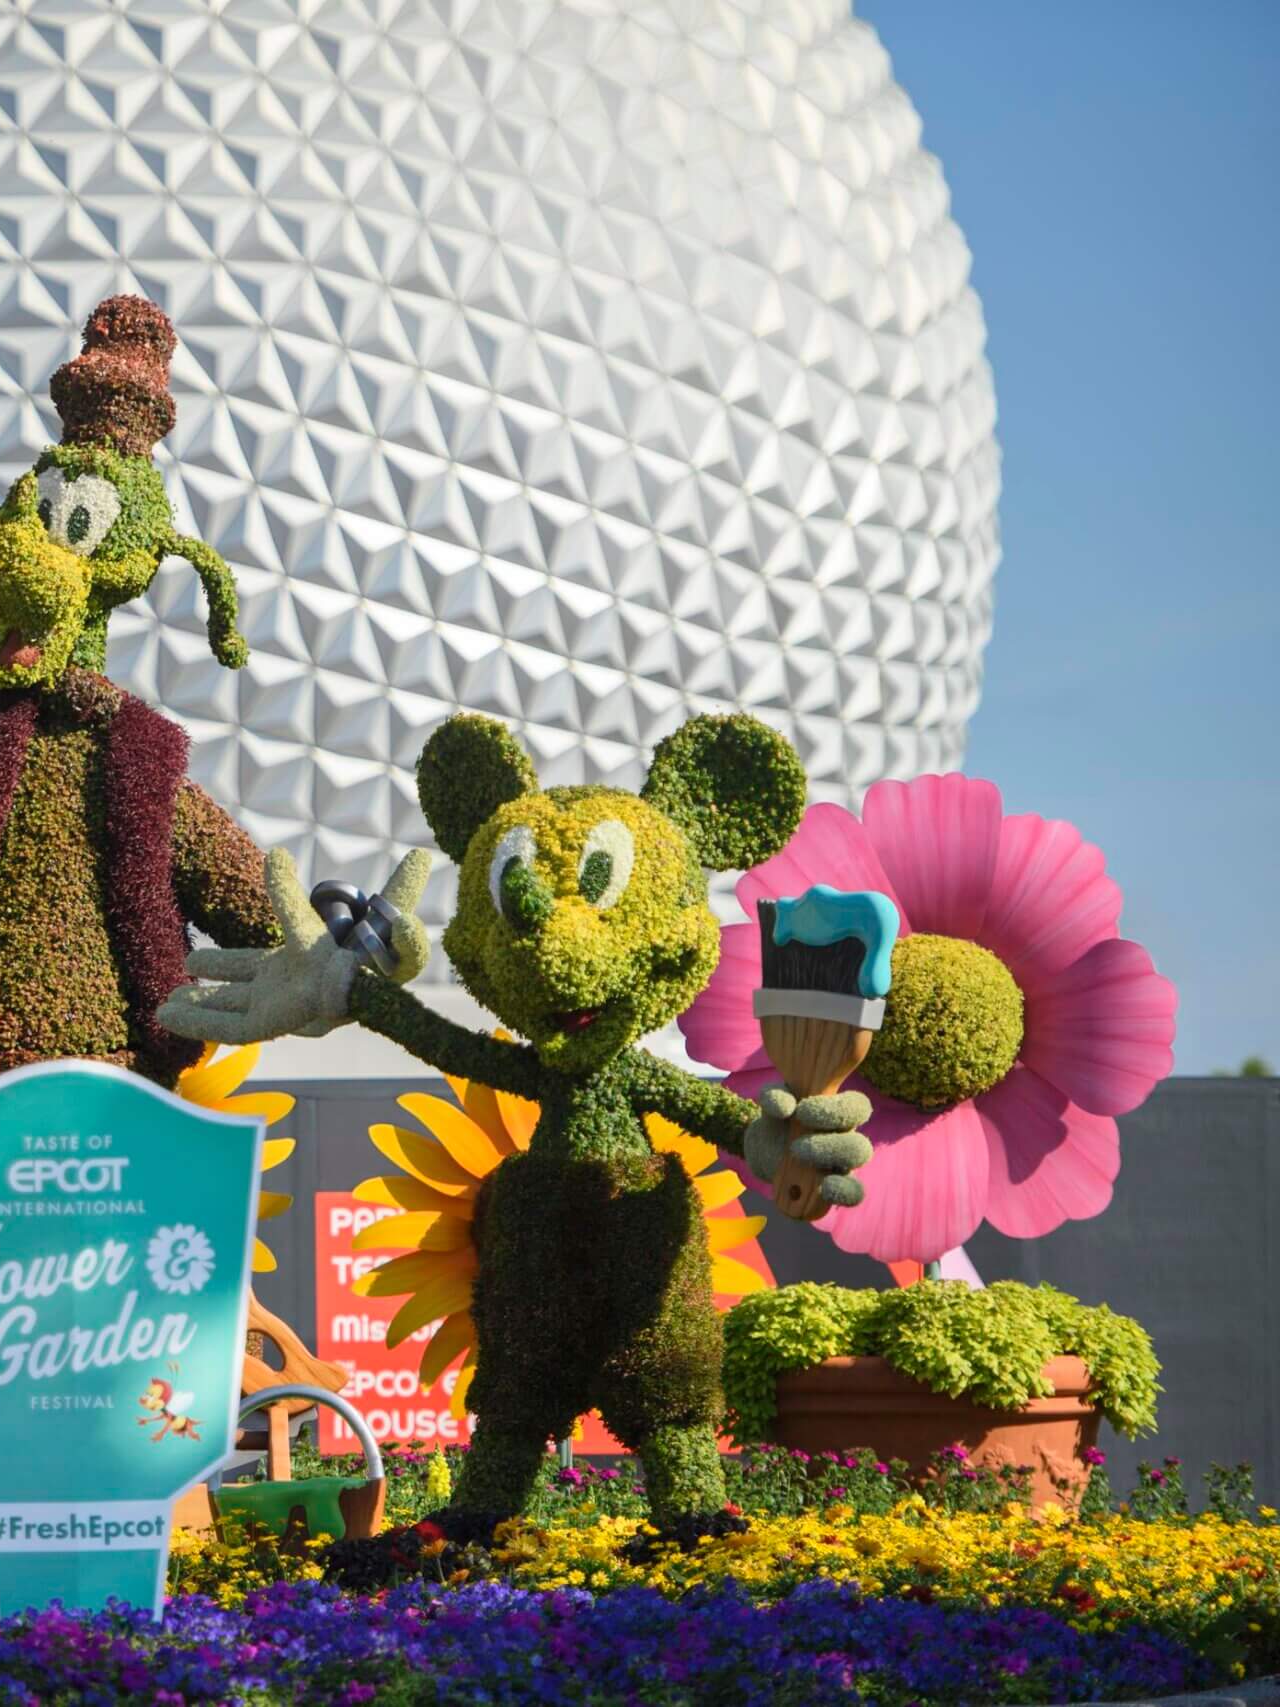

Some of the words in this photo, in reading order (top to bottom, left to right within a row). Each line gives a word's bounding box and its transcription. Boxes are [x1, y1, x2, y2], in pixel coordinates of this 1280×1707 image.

[23, 1135, 80, 1151] TASTE
[88, 1134, 113, 1149] OF
[7, 1156, 130, 1193] EPCOT
[338, 1370, 432, 1398] PCO
[30, 1395, 115, 1410] FESTIVAL
